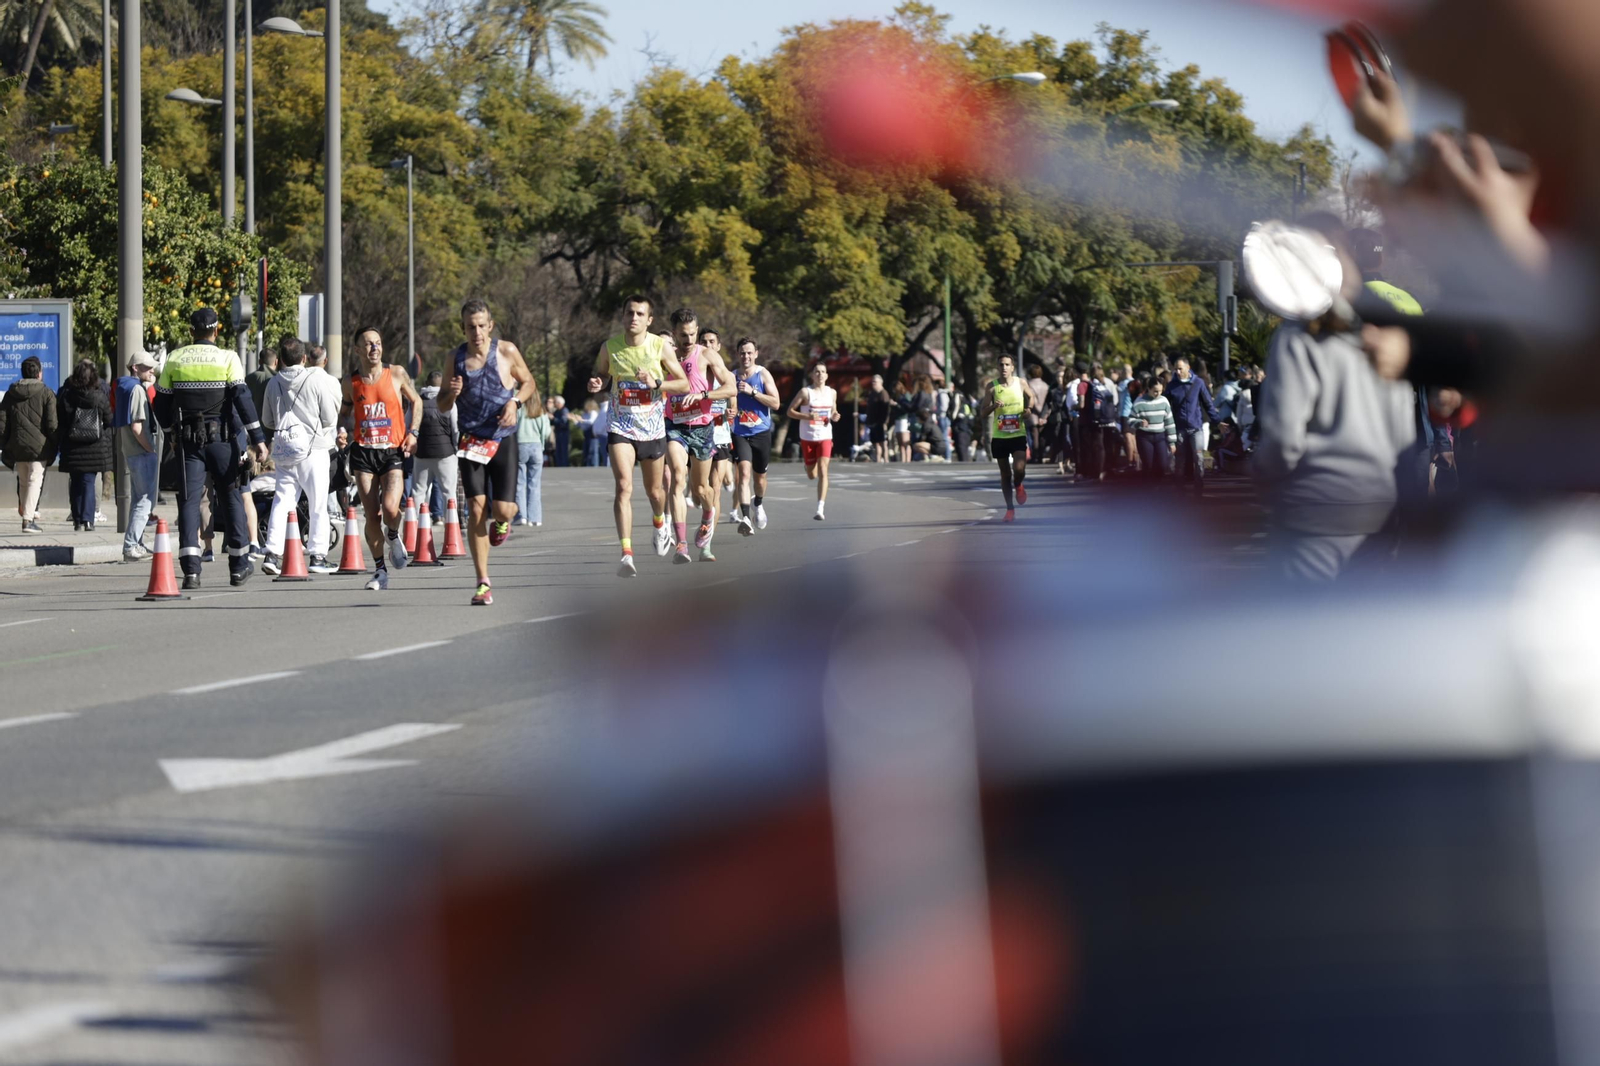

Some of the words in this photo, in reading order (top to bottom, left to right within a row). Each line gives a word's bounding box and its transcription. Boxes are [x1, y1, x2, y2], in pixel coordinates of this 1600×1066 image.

[17, 320, 55, 329] fotocasa
[12, 343, 49, 352] persona.
[5, 353, 22, 361] app
[180, 356, 217, 364] SEVILLA
[364, 435, 389, 443] MATTEO
